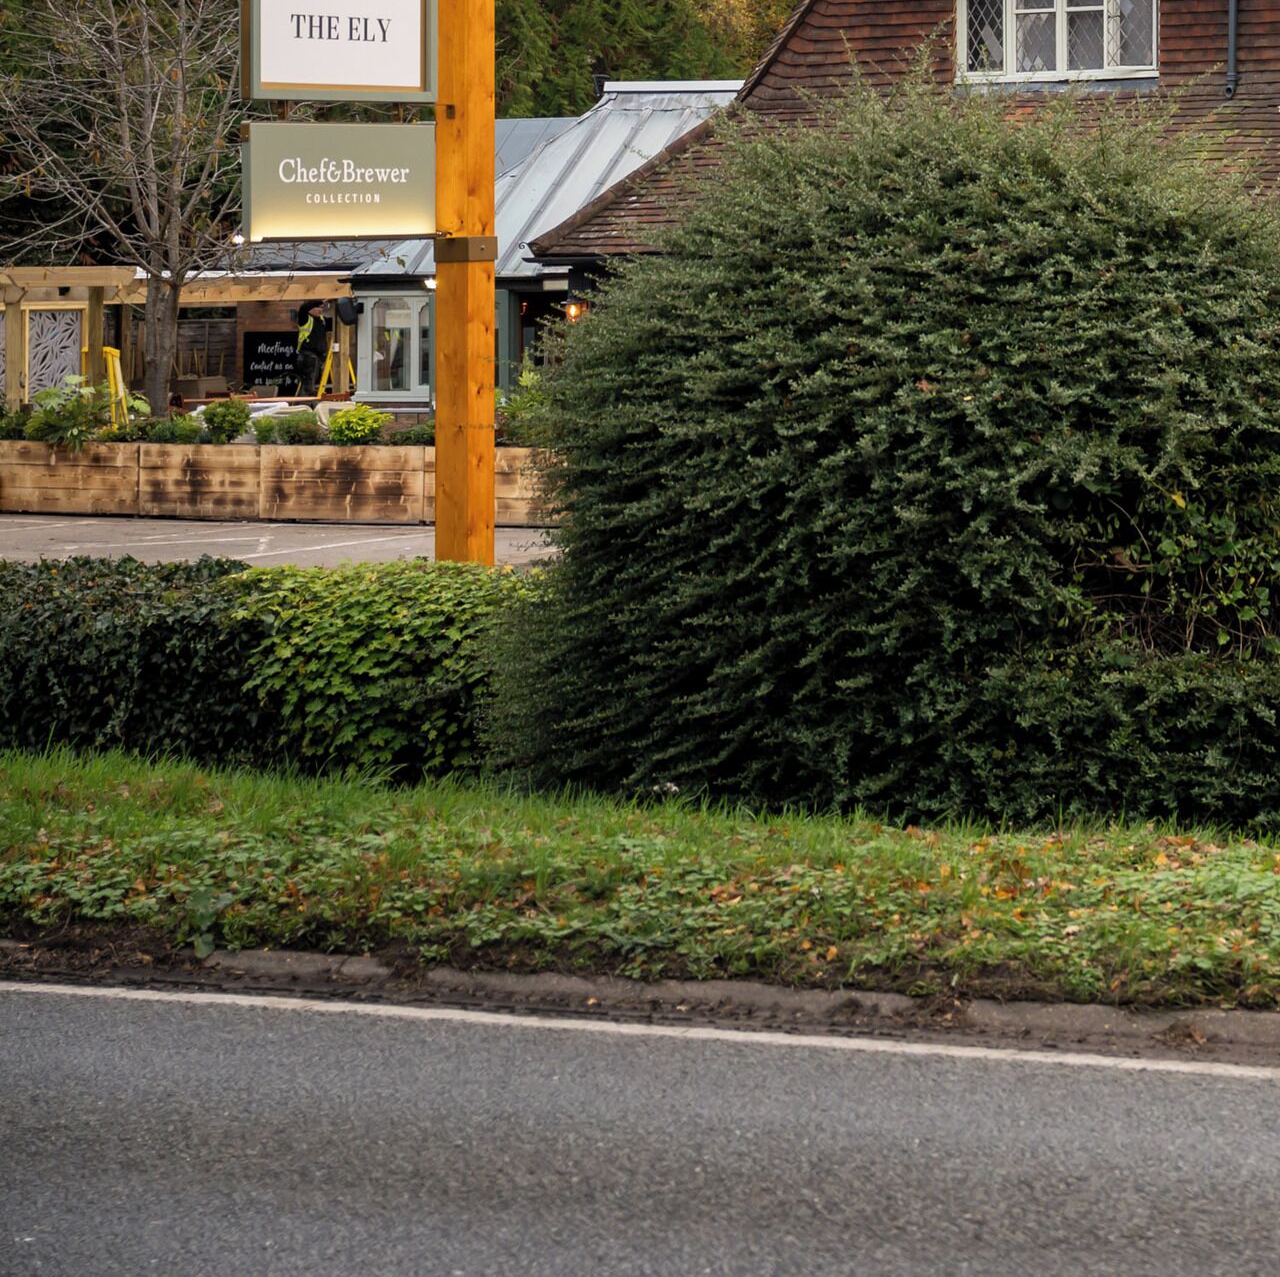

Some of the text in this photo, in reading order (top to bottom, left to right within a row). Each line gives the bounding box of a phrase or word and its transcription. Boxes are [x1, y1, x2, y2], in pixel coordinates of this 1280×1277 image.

[290, 13, 392, 43] THE ELY
[278, 157, 410, 183] Chef&Brewer
[306, 193, 380, 204] COLLECTION
[258, 342, 294, 357] Meetings
